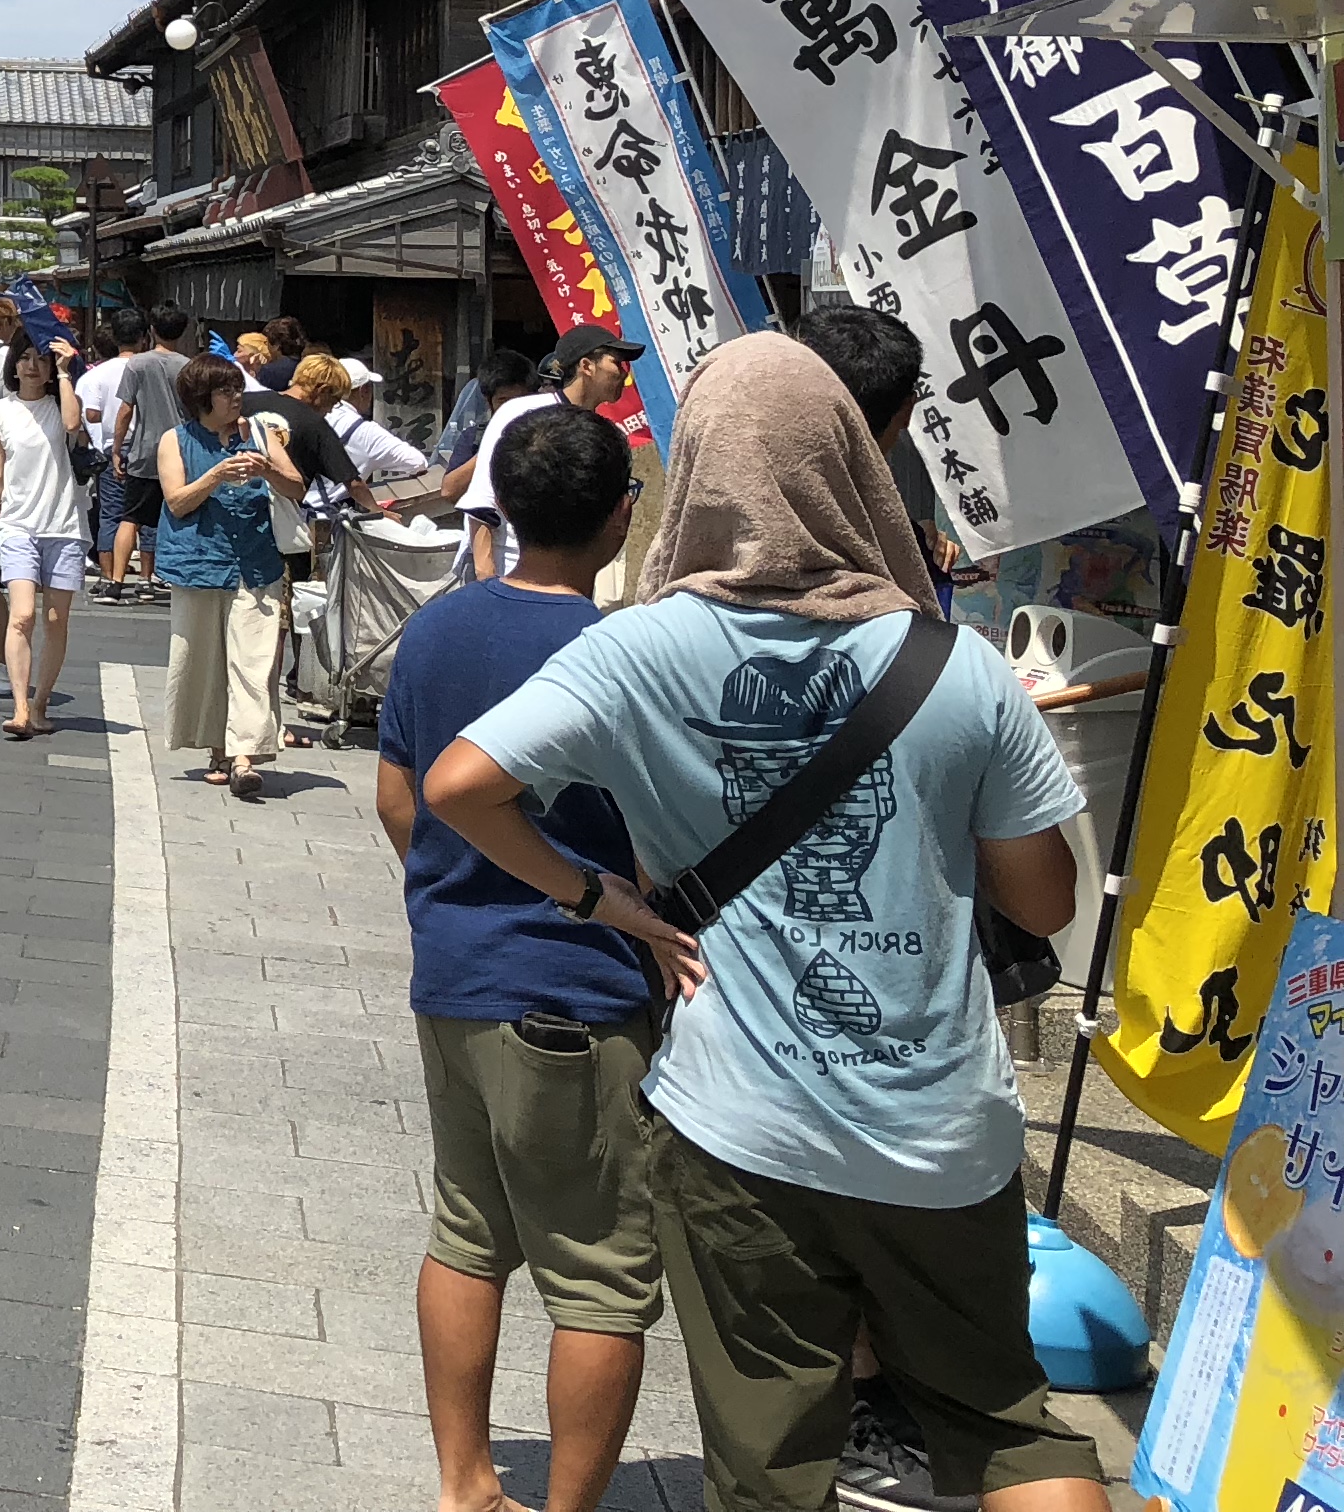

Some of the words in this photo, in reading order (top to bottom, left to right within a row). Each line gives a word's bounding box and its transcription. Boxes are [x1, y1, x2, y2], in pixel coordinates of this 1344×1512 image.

[1049, 58, 1263, 353] 百草
[854, 242, 1000, 528] 小西金丹本舗
[813, 1037, 927, 1077] gonzales
